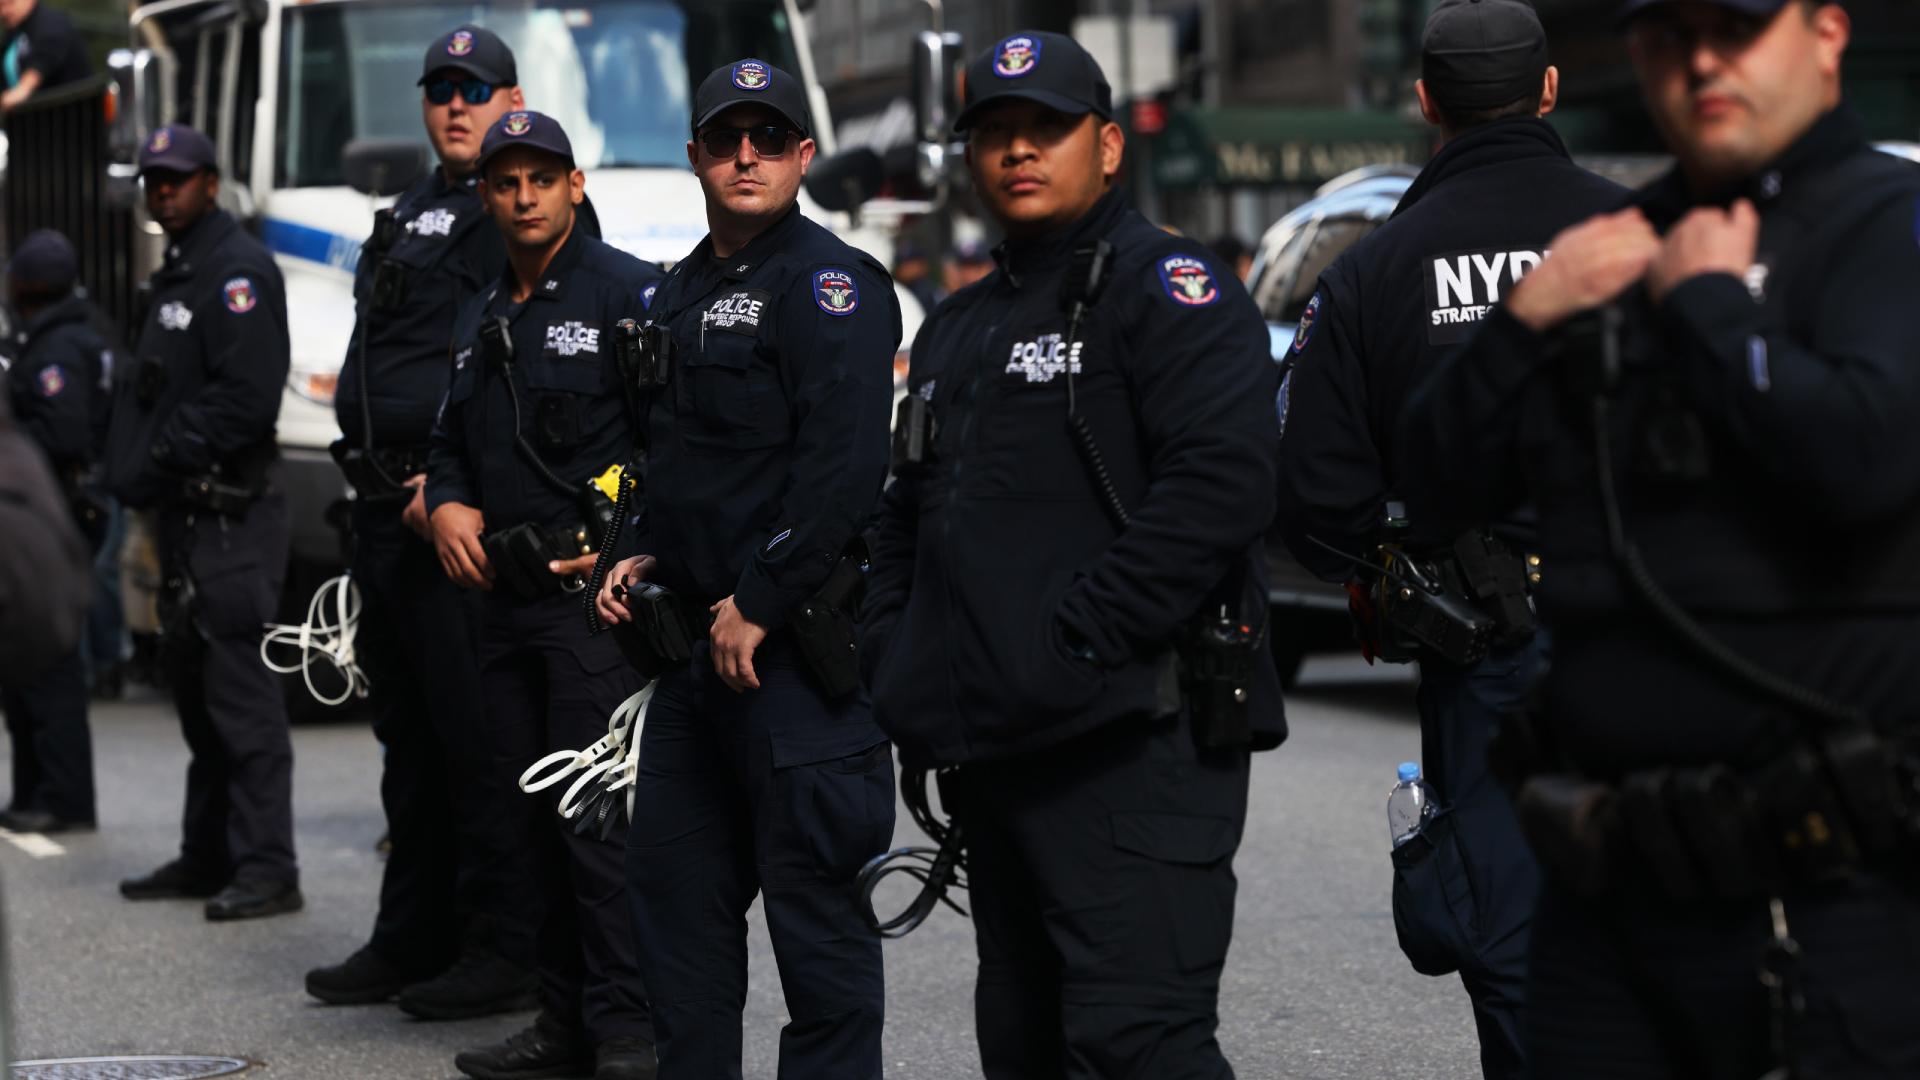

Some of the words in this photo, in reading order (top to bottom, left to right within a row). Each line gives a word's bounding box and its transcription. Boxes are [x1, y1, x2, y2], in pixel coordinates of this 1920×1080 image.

[741, 62, 763, 70] NYPD
[819, 271, 852, 285] POLICE
[1433, 250, 1551, 308] NYP
[709, 298, 763, 318] POLICE
[547, 325, 600, 345] POLICE
[1009, 341, 1083, 363] POLICE
